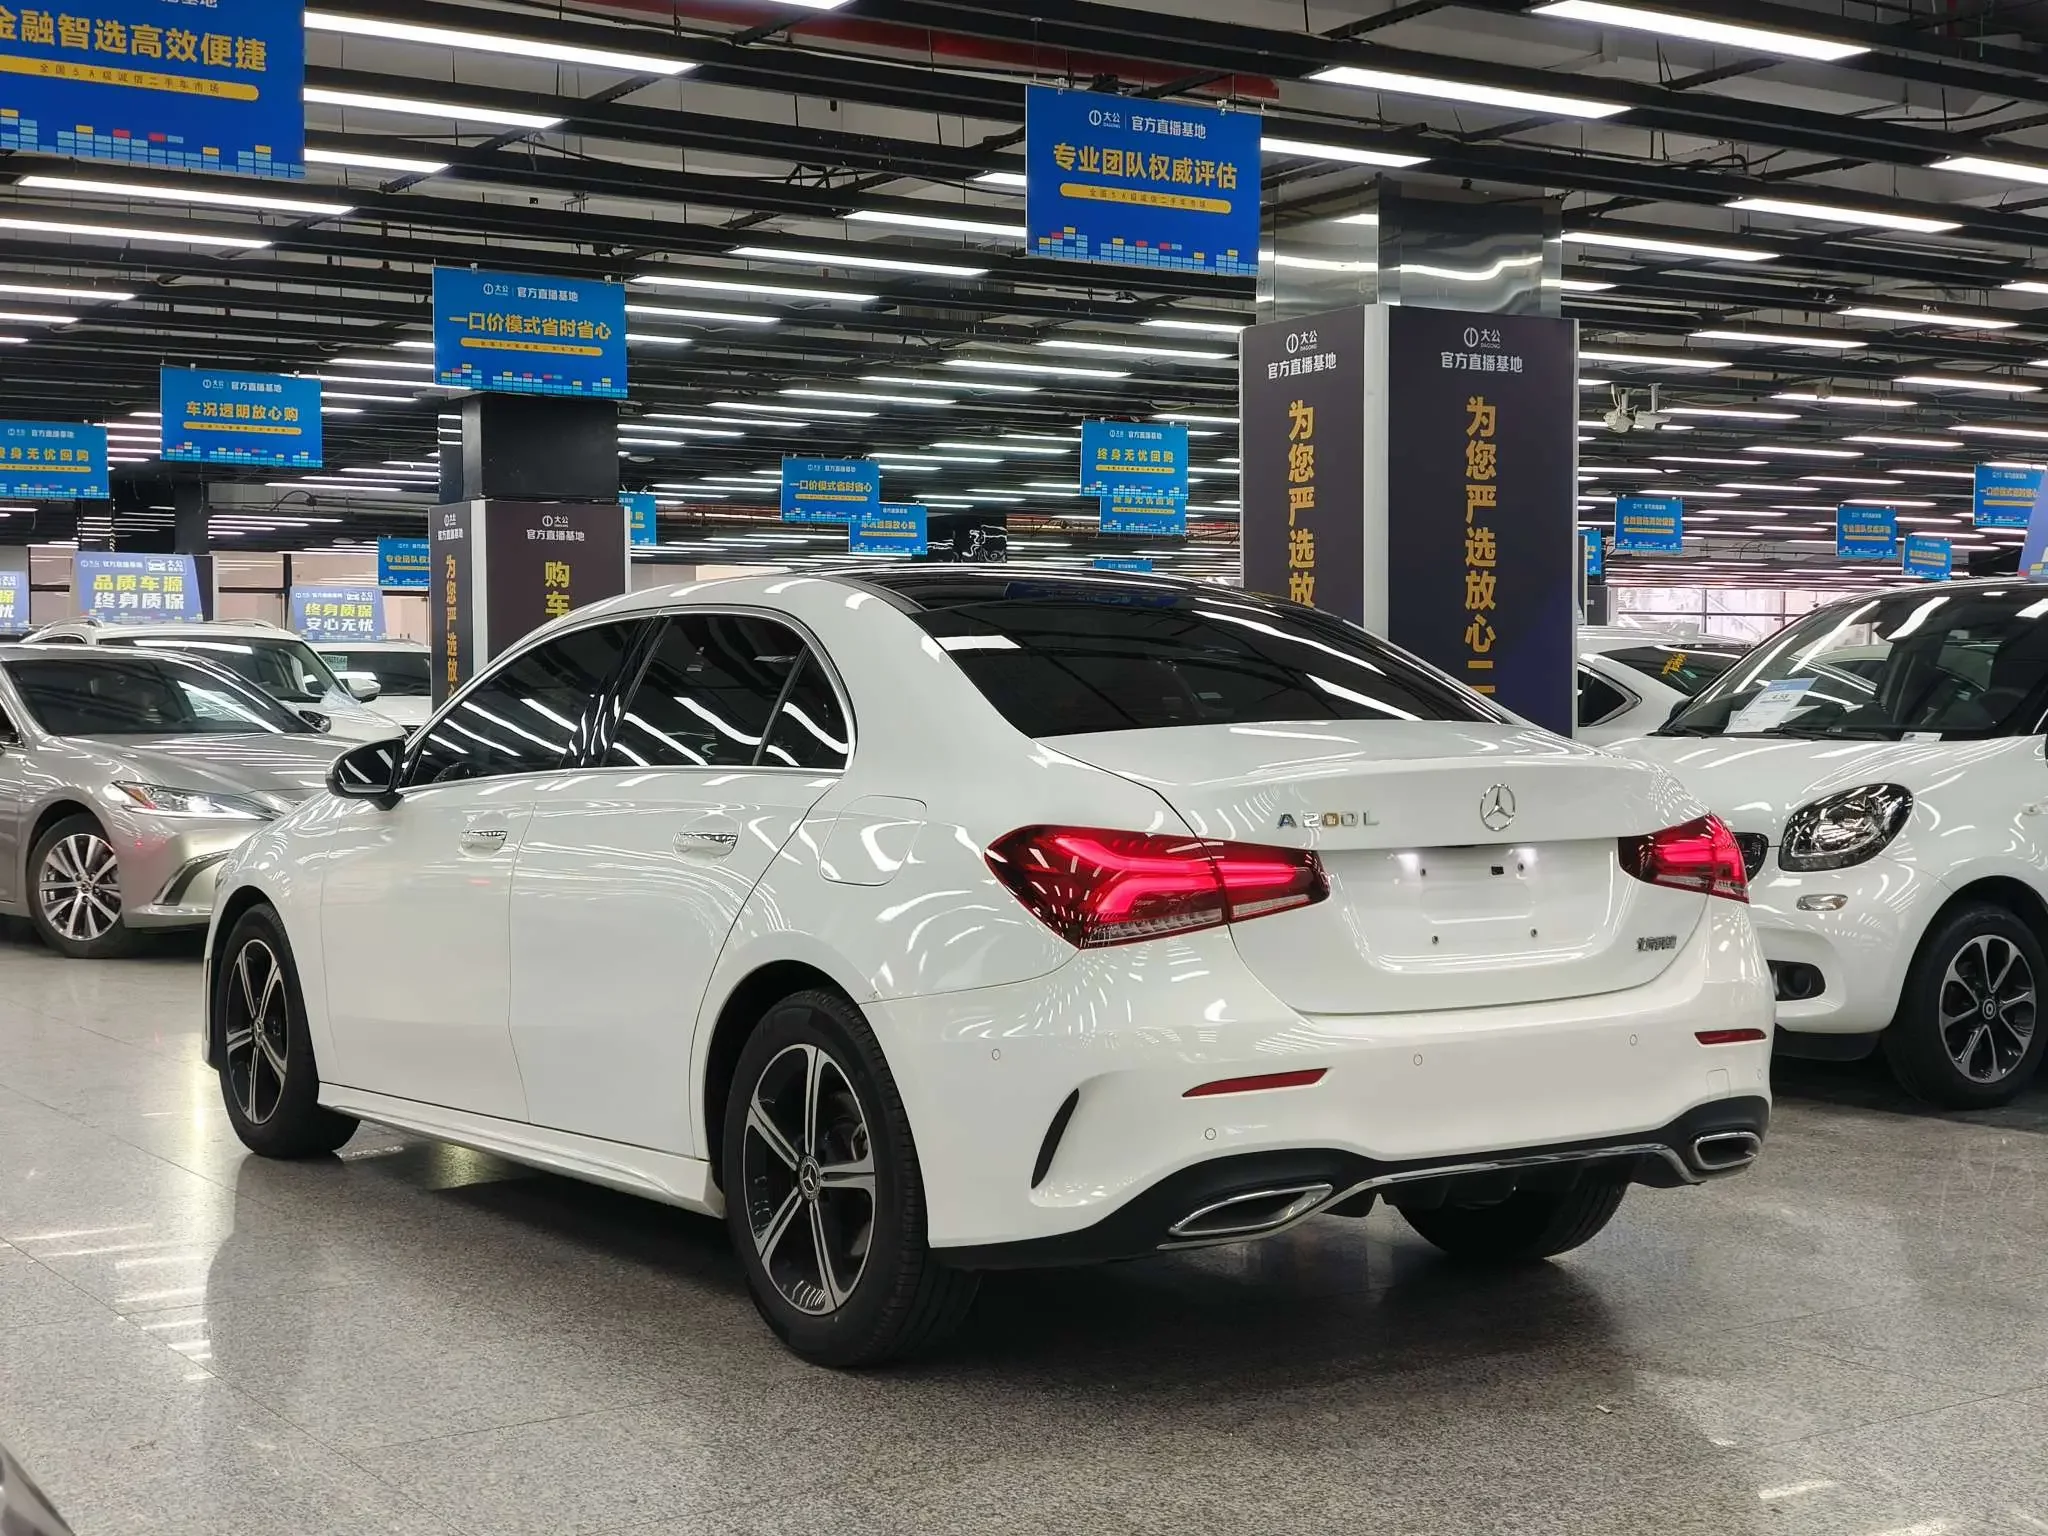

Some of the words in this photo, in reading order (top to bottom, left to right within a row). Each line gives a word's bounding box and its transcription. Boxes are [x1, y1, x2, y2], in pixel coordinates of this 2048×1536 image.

[1103, 112, 1120, 123] 大公
[1131, 116, 1207, 139] 官方直播基地
[1053, 143, 1238, 190] 专业团队权威评估
[449, 312, 612, 340] 一口价模式省时省心
[1300, 329, 1318, 345] 大公
[1480, 328, 1501, 342] 大公
[1267, 352, 1337, 379] 官方直播基地
[1440, 351, 1523, 373] 官方直播基地
[186, 401, 299, 422] 车况透明放心购
[554, 515, 568, 524] 大公
[526, 529, 585, 541] 官方直播基地
[94, 574, 183, 592] 品质车源
[95, 592, 184, 609] 终身质保
[305, 602, 373, 617] 终身质保
[306, 617, 374, 632] 安心无忧
